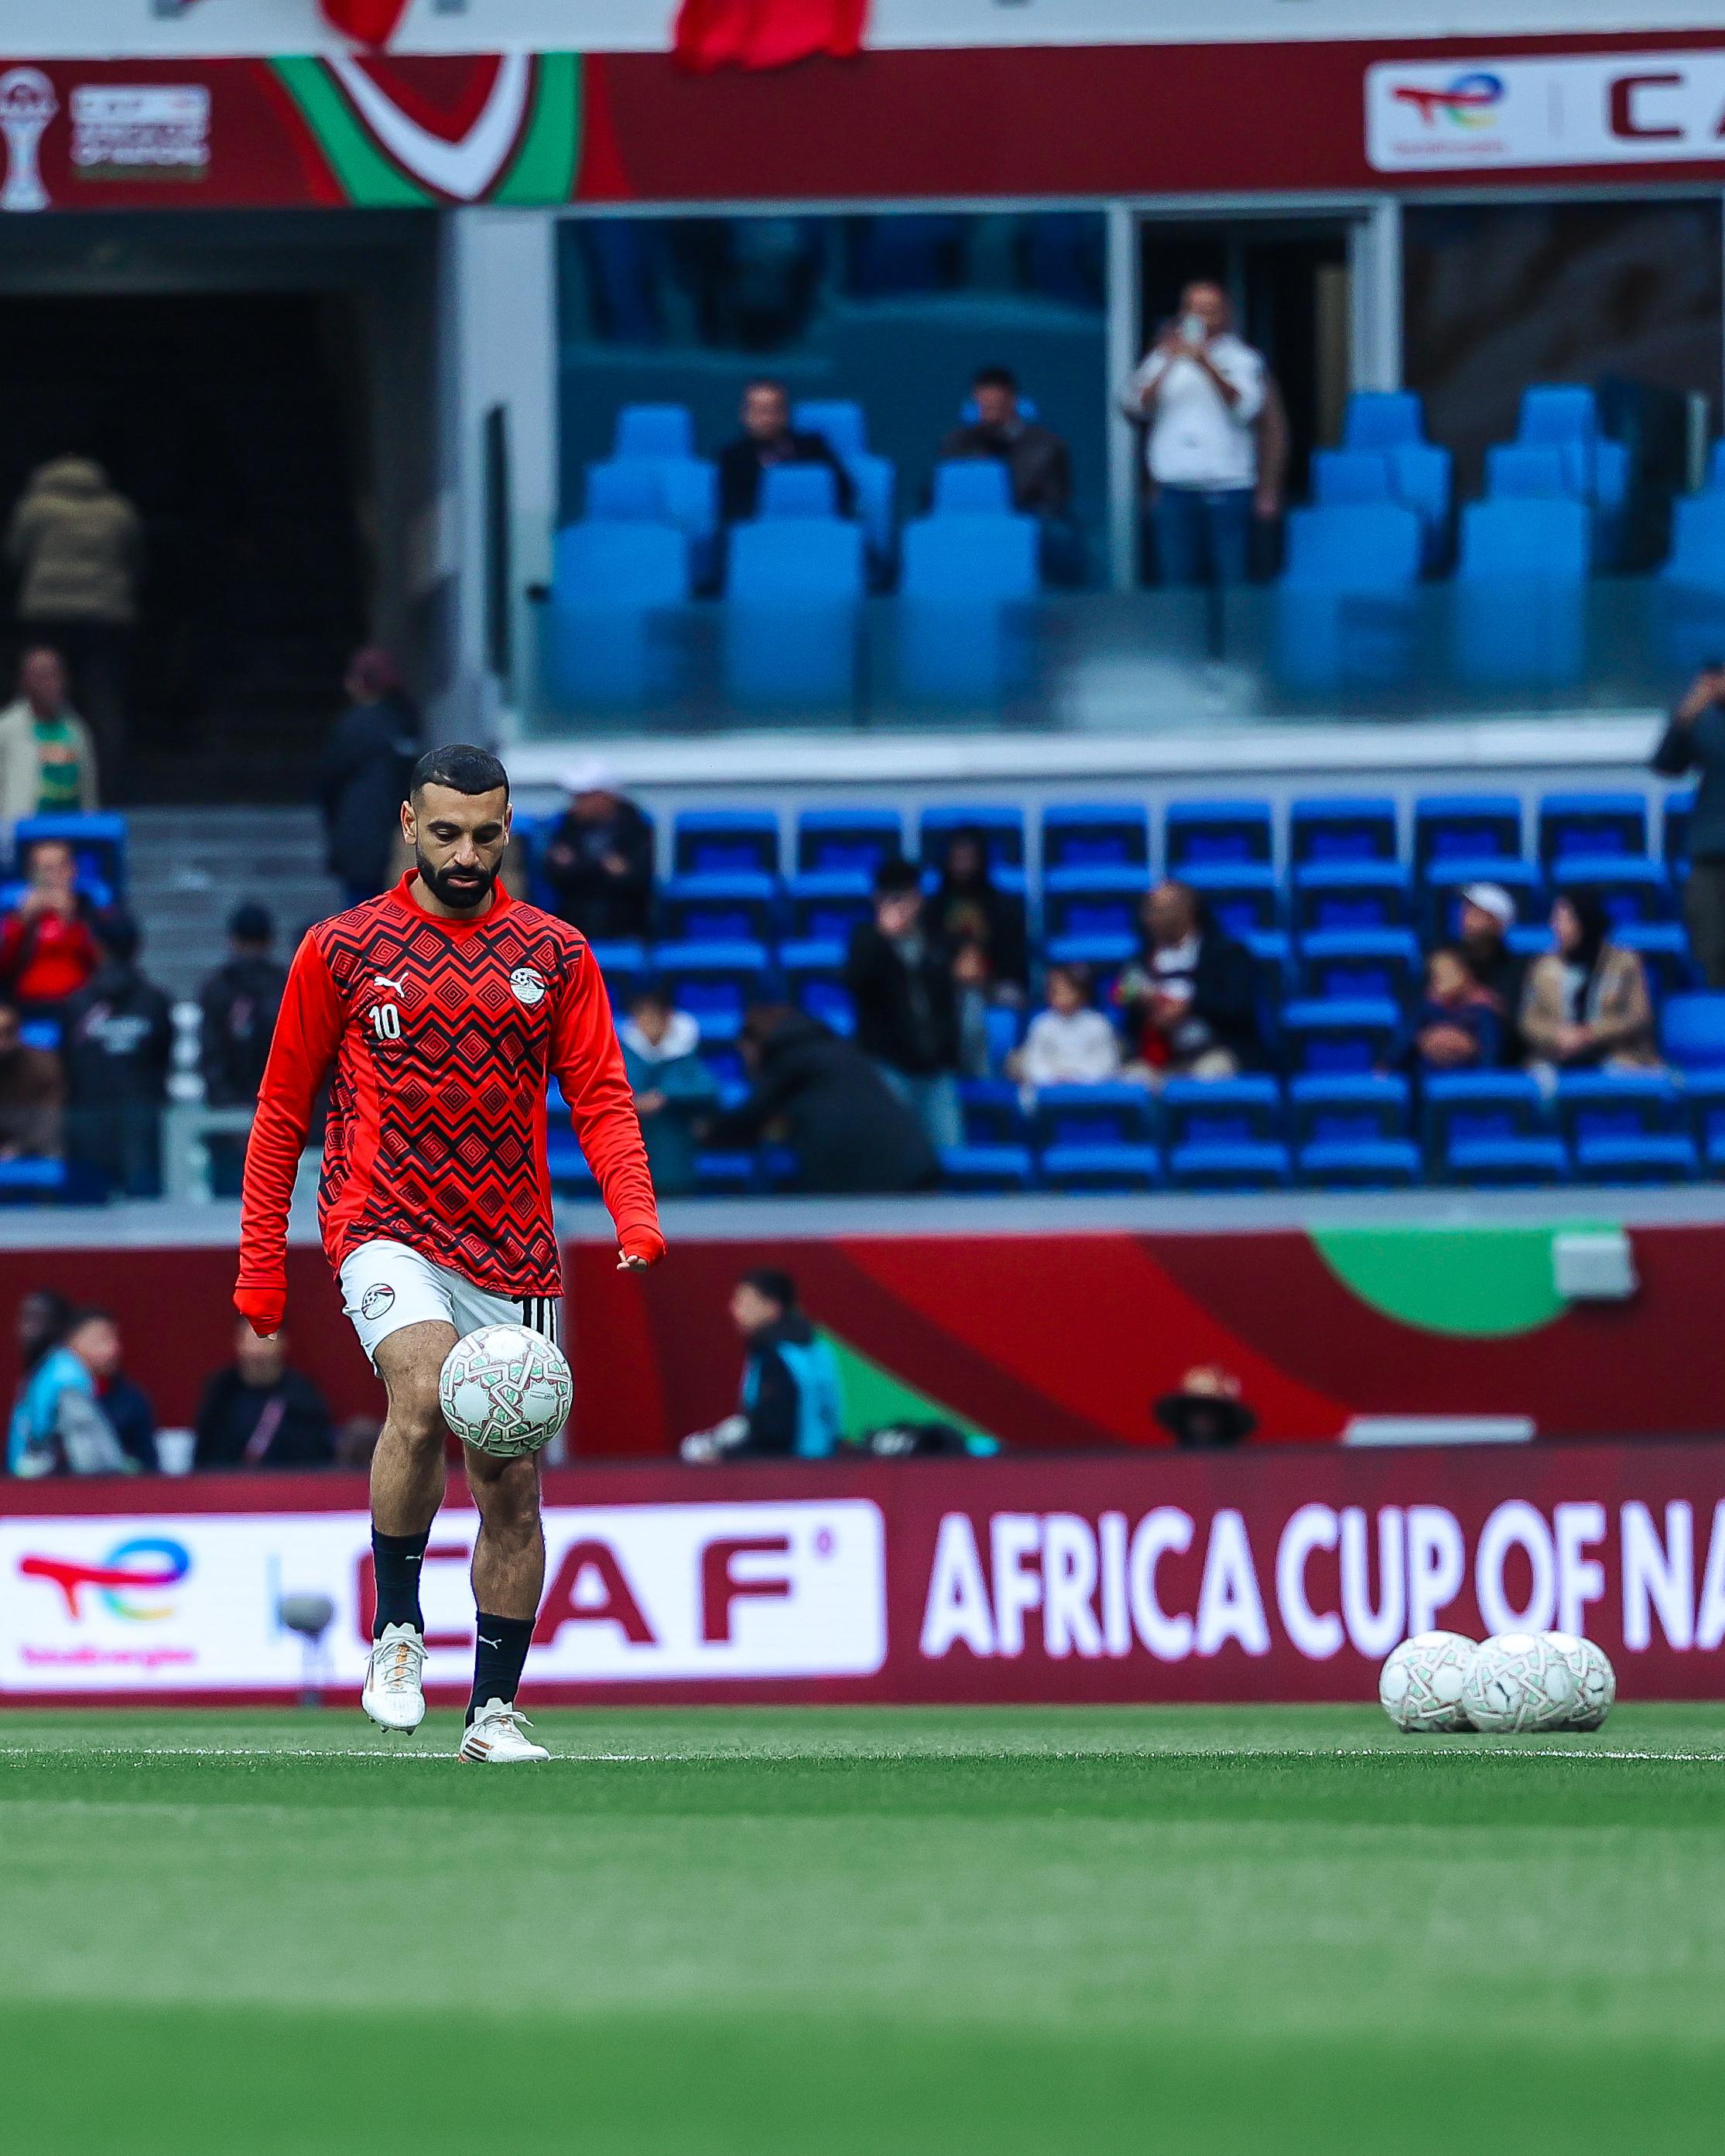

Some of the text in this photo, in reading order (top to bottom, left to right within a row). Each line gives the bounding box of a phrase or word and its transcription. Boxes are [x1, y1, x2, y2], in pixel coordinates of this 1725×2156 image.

[1608, 73, 1725, 142] C
[368, 1003, 401, 1040] 10
[356, 1535, 791, 1650] CAF
[921, 1506, 1270, 1661] AFRICA
[1276, 1503, 1465, 1660] CUP
[1474, 1499, 1607, 1637] OF
